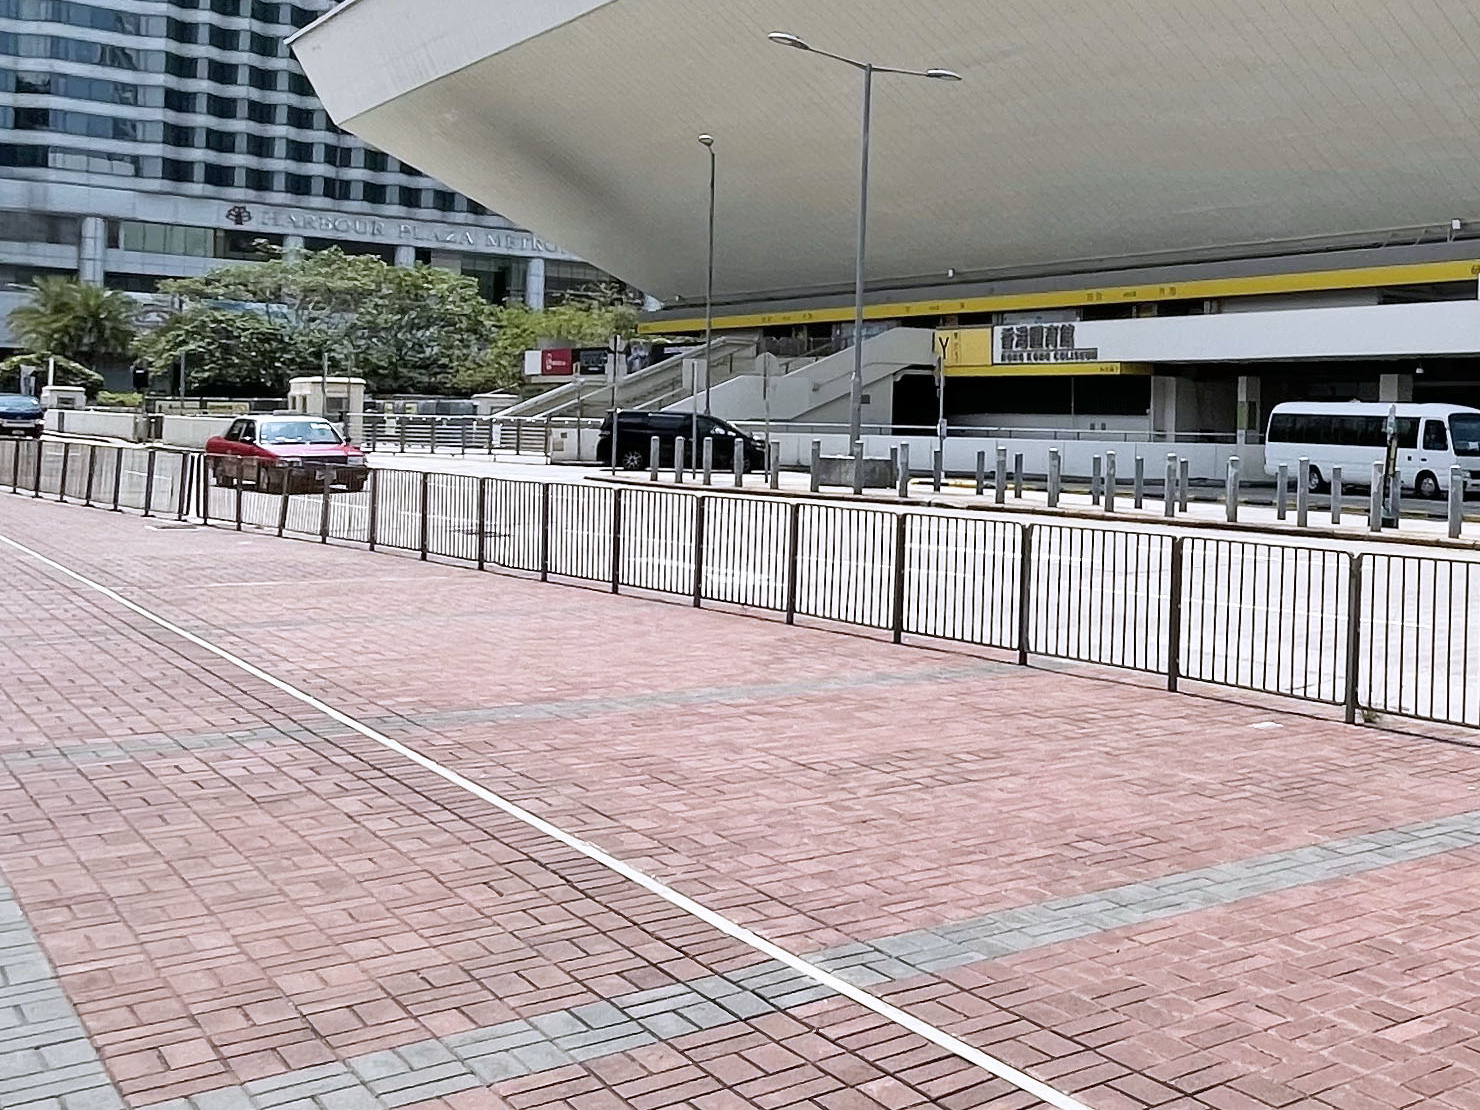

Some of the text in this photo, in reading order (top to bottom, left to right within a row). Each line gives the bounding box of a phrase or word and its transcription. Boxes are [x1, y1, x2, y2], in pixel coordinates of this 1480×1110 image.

[259, 210, 567, 254] HARBOUR PLAZA METRO
[1001, 351, 1024, 363] HONG
[1027, 350, 1051, 362] KONG
